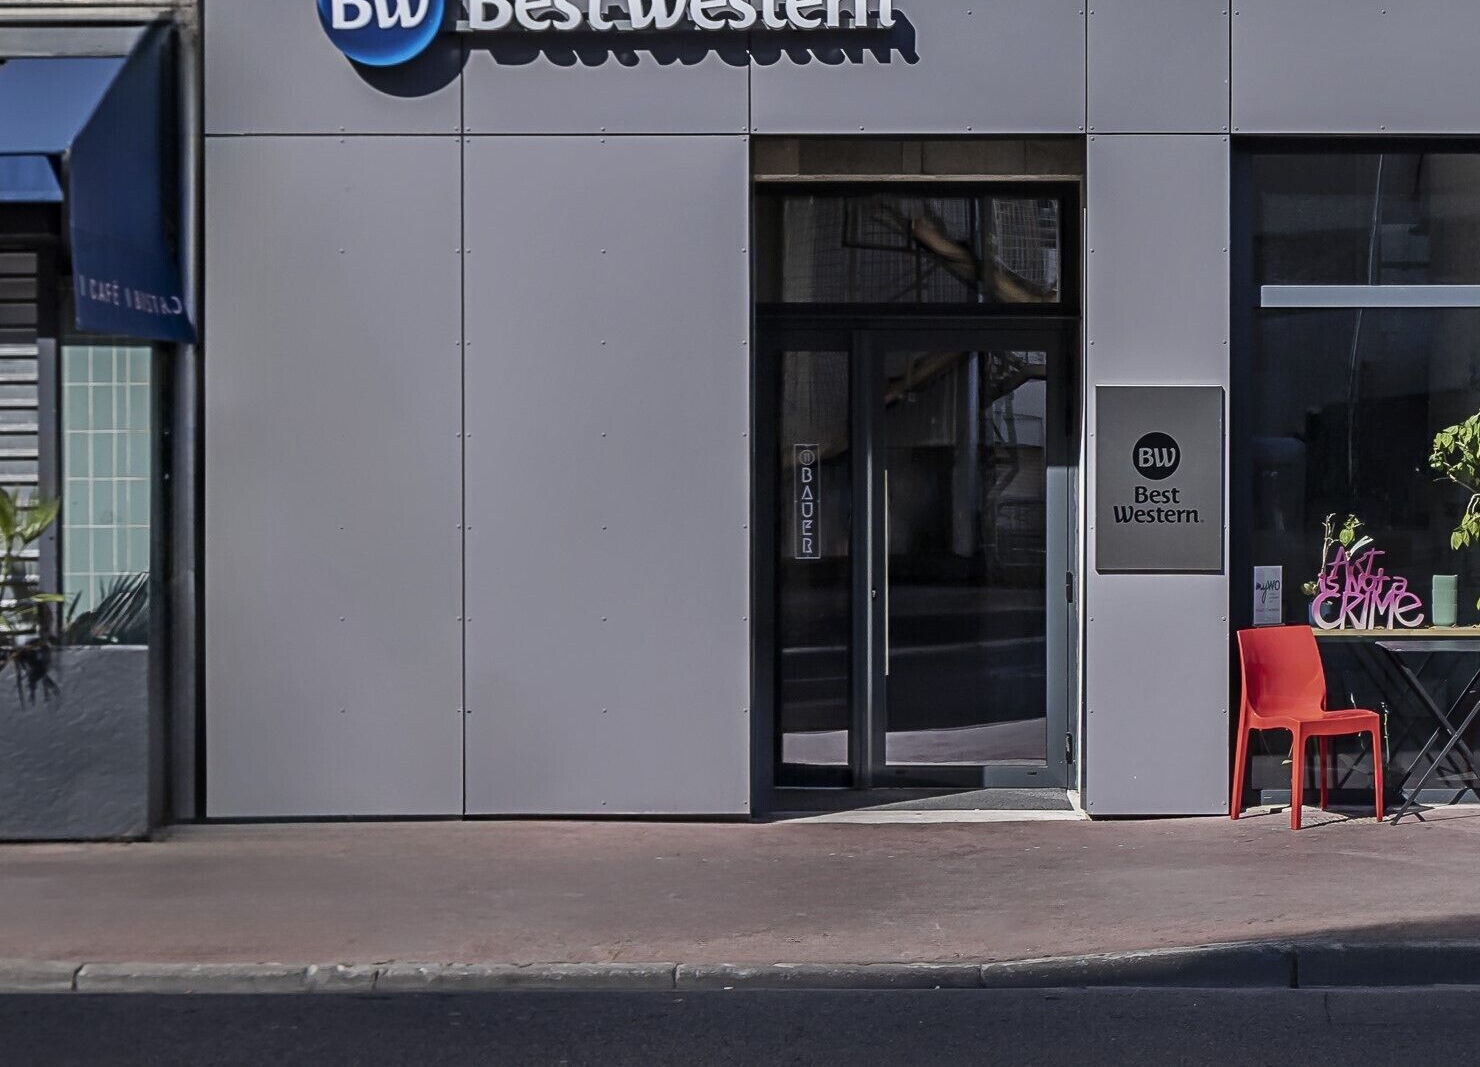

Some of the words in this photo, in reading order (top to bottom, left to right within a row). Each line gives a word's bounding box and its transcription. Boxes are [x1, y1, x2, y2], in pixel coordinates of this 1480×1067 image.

[1138, 447, 1176, 468] BW
[1134, 486, 1180, 504] Best
[801, 467, 814, 554] BAUER
[1113, 505, 1200, 524] Western
